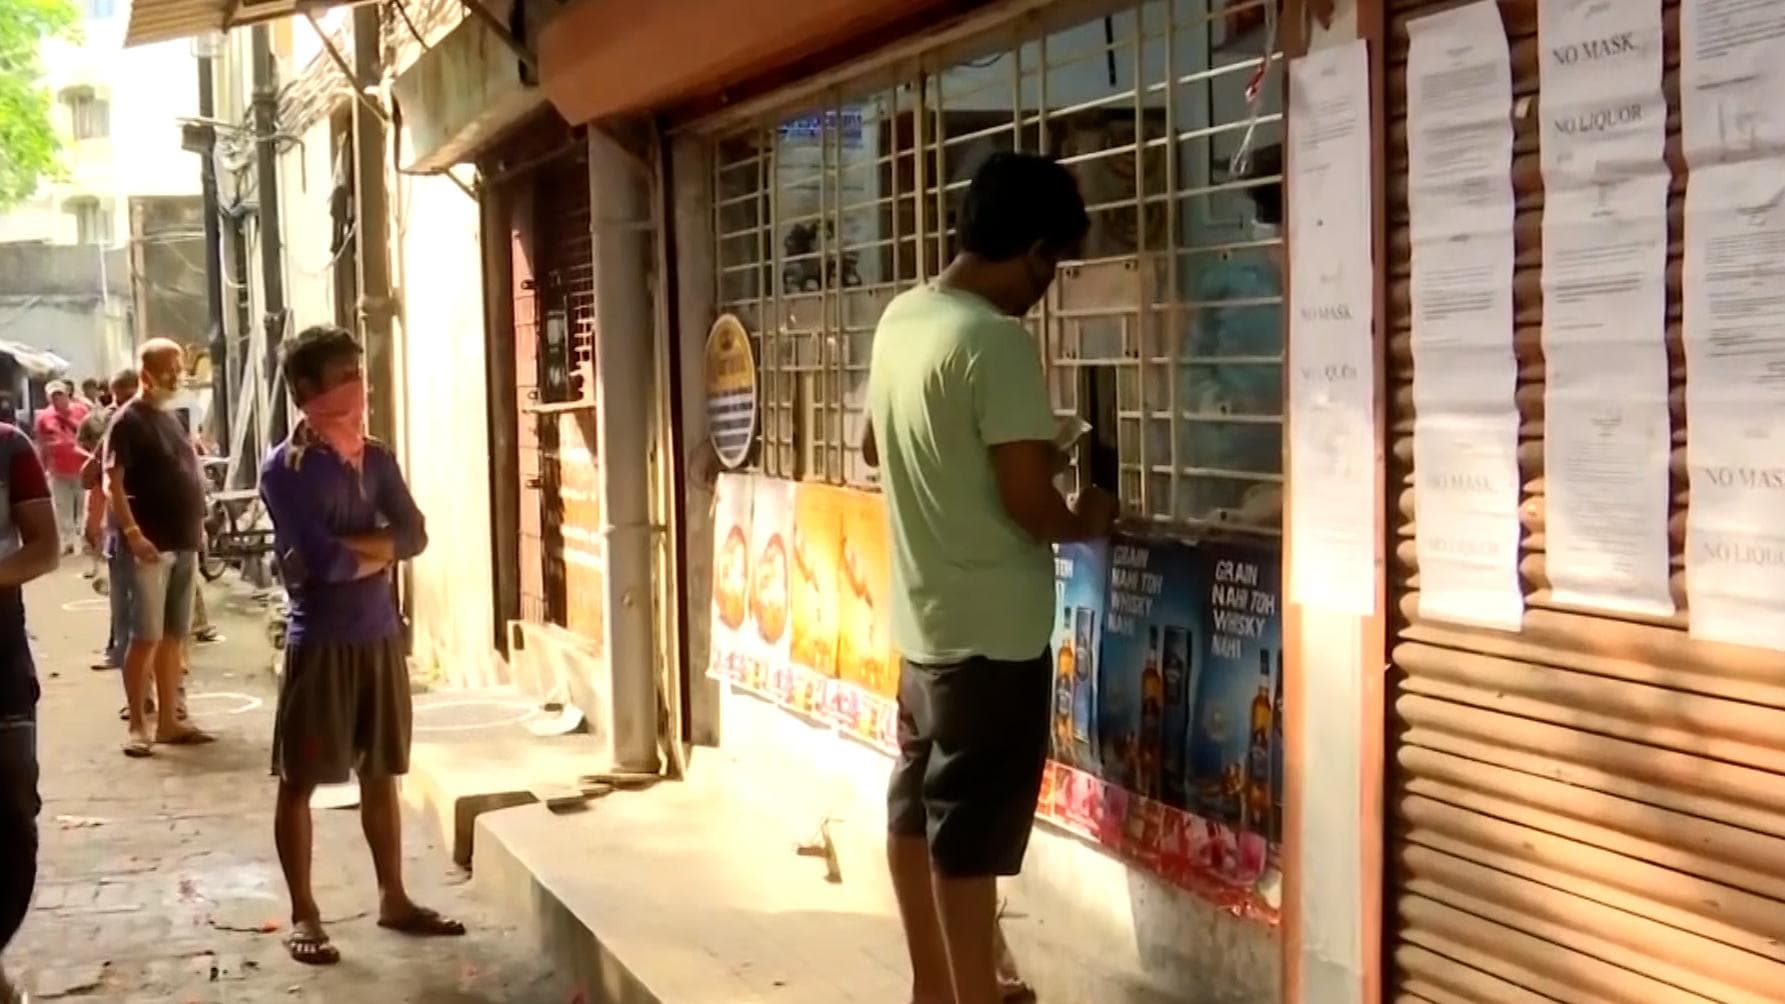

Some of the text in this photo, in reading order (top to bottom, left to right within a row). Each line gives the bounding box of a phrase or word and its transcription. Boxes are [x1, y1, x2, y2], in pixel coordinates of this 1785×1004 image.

[1552, 31, 1635, 66] NO MASK
[1554, 102, 1642, 135] NO LIQUOR
[1704, 465, 1734, 488] NO
[1703, 542, 1731, 560] NO
[1215, 560, 1258, 586] GRAIN
[1212, 583, 1276, 616] NAHI TOH
[1213, 608, 1266, 638] WHISKY
[1211, 633, 1242, 659] NAHI
